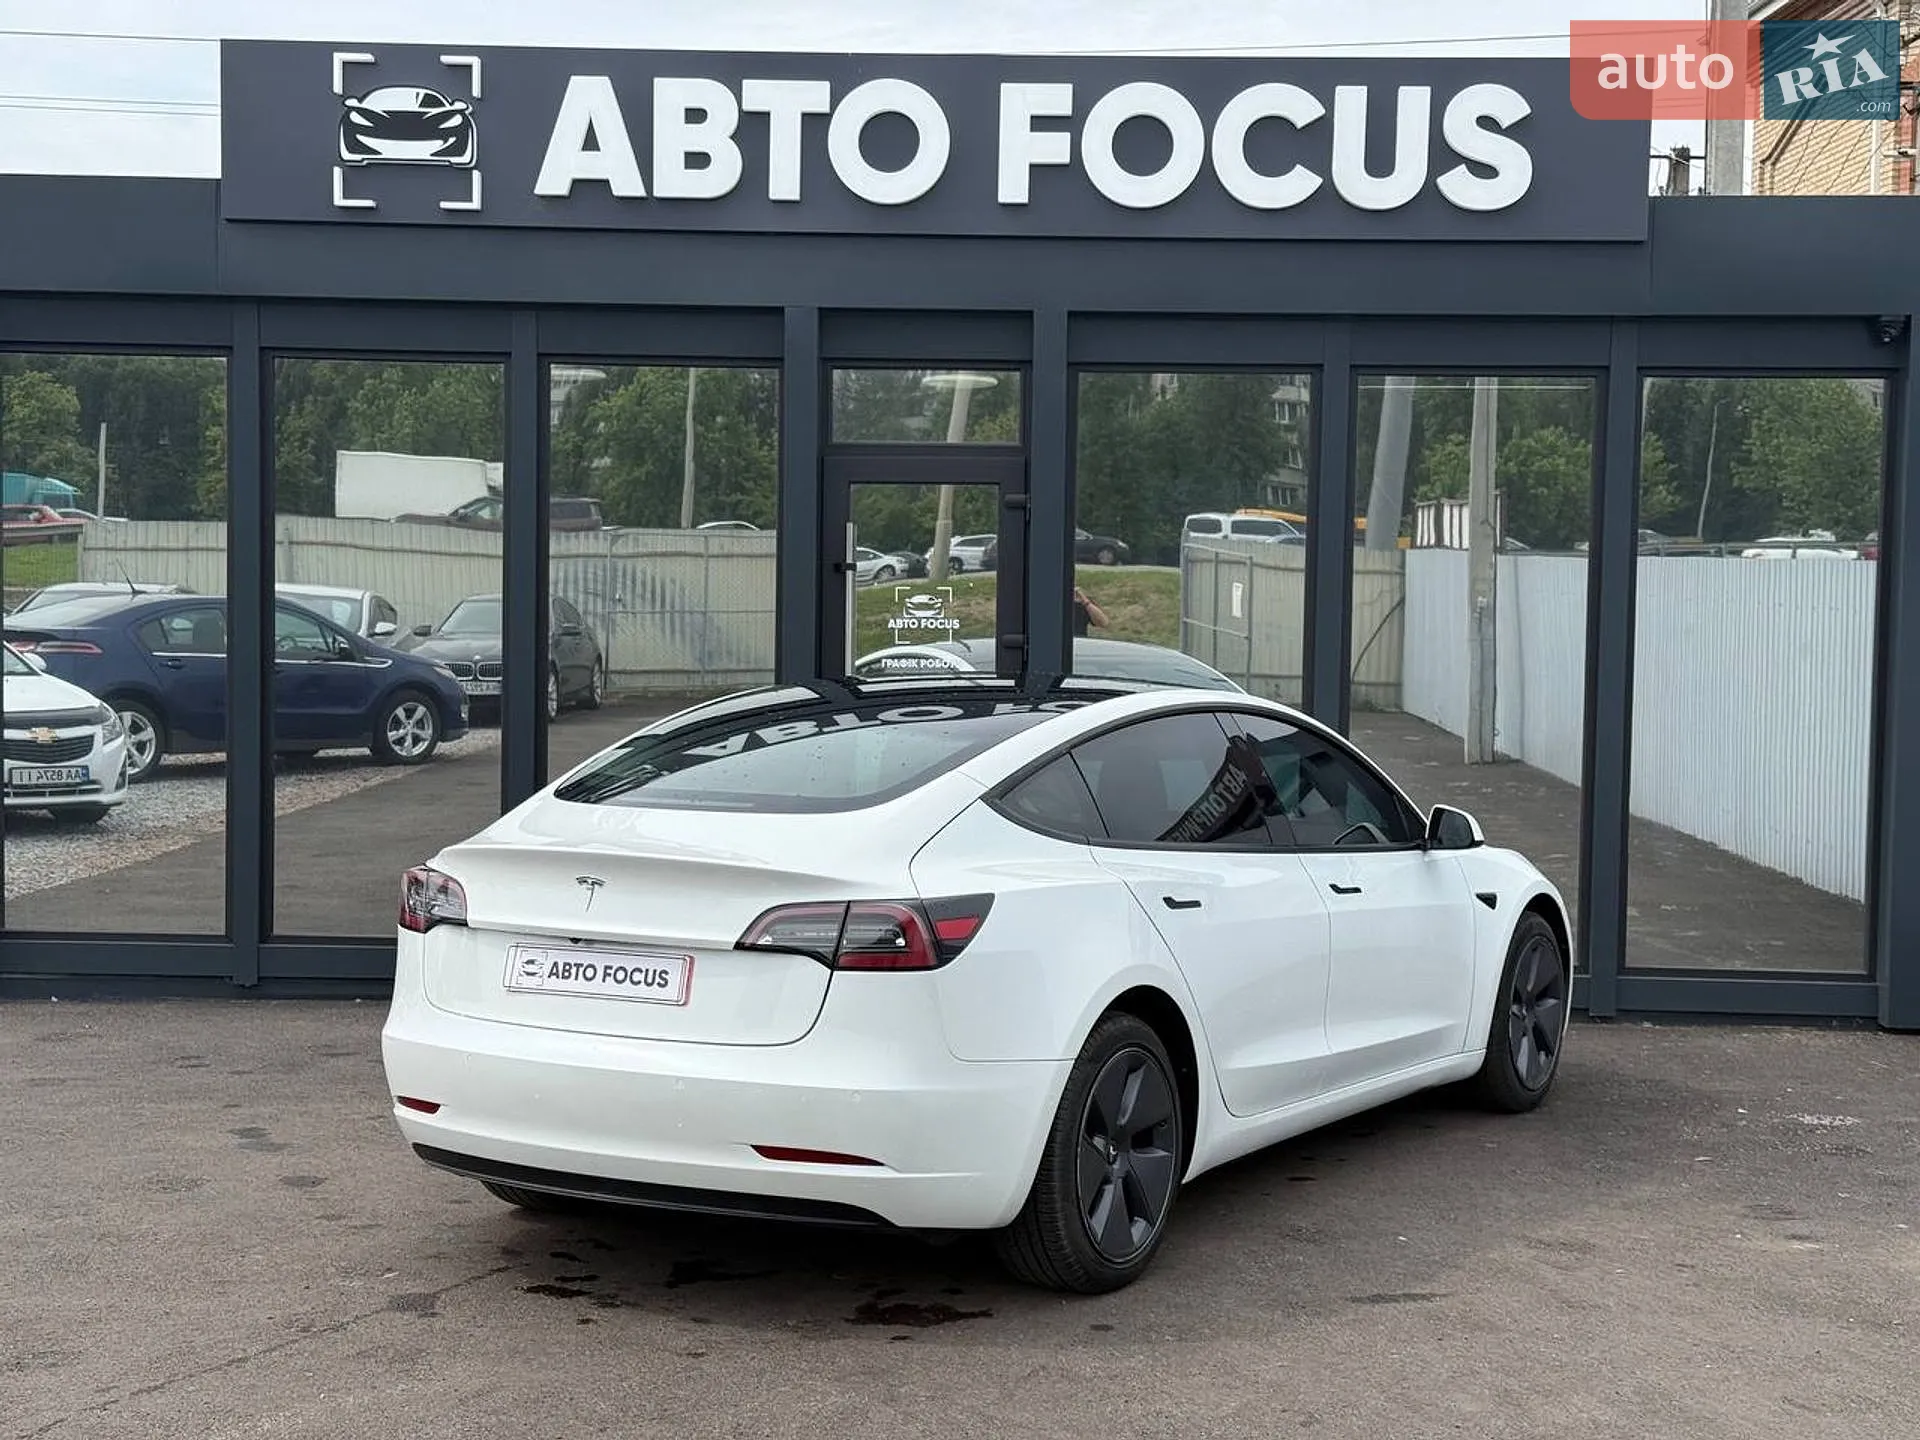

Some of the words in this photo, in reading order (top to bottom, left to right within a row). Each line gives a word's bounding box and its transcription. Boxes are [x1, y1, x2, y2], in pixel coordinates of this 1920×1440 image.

[534, 75, 950, 205] АВТО
[998, 81, 1533, 211] FOCUS
[888, 619, 918, 629] АВТО
[921, 619, 960, 629] FOCUS
[547, 961, 597, 982] АВТО
[601, 964, 671, 989] FOCUS
